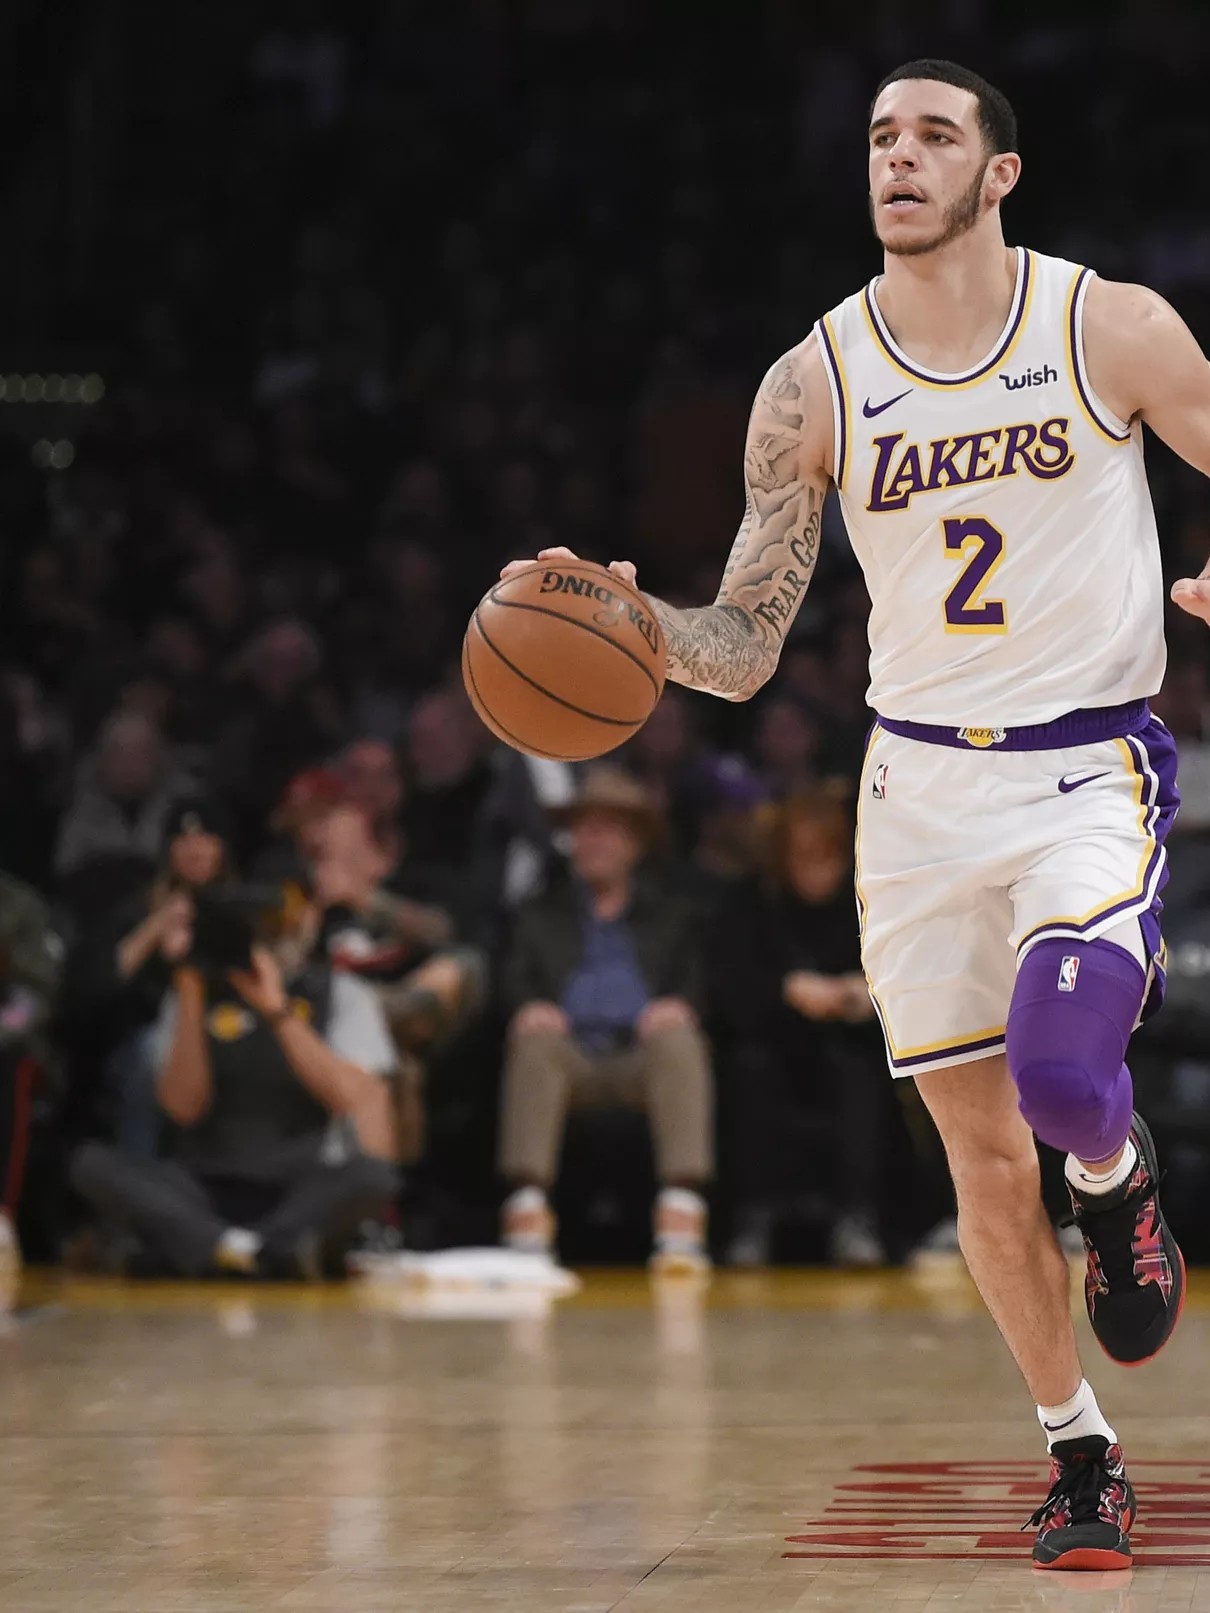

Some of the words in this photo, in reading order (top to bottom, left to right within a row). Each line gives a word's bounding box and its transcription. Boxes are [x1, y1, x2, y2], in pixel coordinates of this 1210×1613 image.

[998, 364, 1058, 391] wish
[867, 417, 1075, 513] LAKERS
[943, 515, 1007, 634] 2
